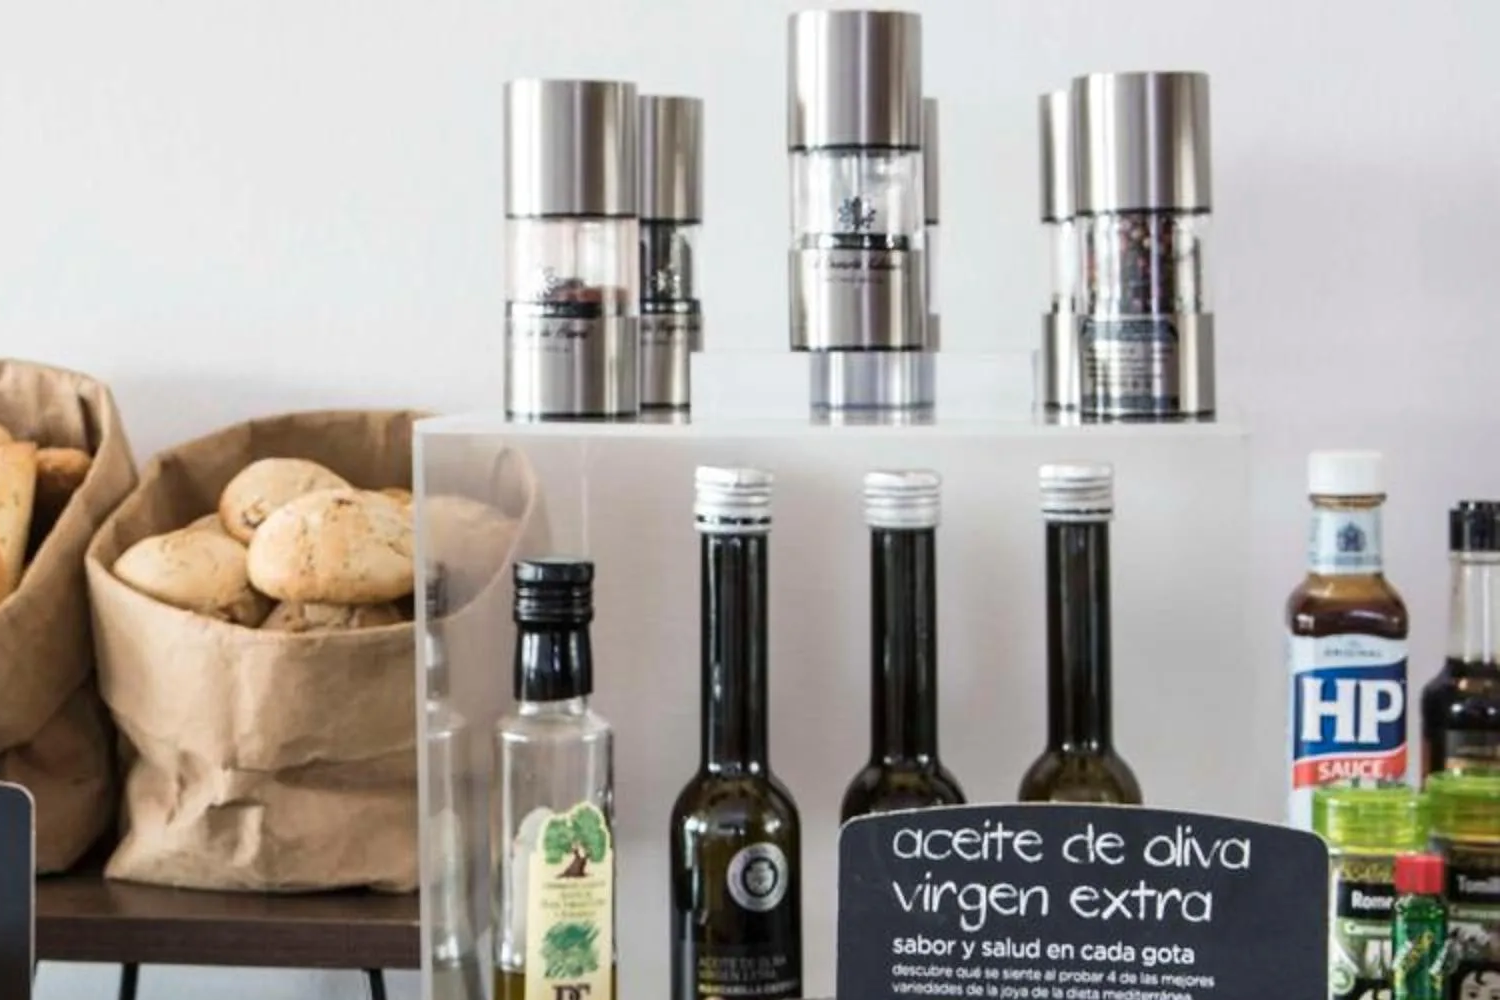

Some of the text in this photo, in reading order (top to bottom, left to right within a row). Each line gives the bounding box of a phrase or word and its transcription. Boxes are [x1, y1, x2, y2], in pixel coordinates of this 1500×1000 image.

[1301, 677, 1404, 743] HP
[1318, 759, 1385, 781] SAUCE
[892, 819, 1251, 869] aceite de oliva
[892, 871, 1212, 931] virgen extra
[892, 934, 1195, 967] sabor y salud en cada gota
[891, 964, 953, 977] descubre
[984, 968, 999, 979] se
[1002, 968, 1041, 981] siente
[1044, 968, 1056, 981] al
[1059, 970, 1104, 984] probar
[1106, 971, 1116, 983] 4
[1119, 972, 1137, 984] de
[1140, 972, 1158, 985] las
[1161, 974, 1215, 989] mejores
[891, 981, 963, 996] variedades
[966, 982, 984, 996] de
[986, 983, 998, 996] la
[1000, 984, 1029, 1000] joya
[1031, 985, 1049, 999] de
[1052, 986, 1063, 999] la
[1066, 986, 1099, 1000] dieta
